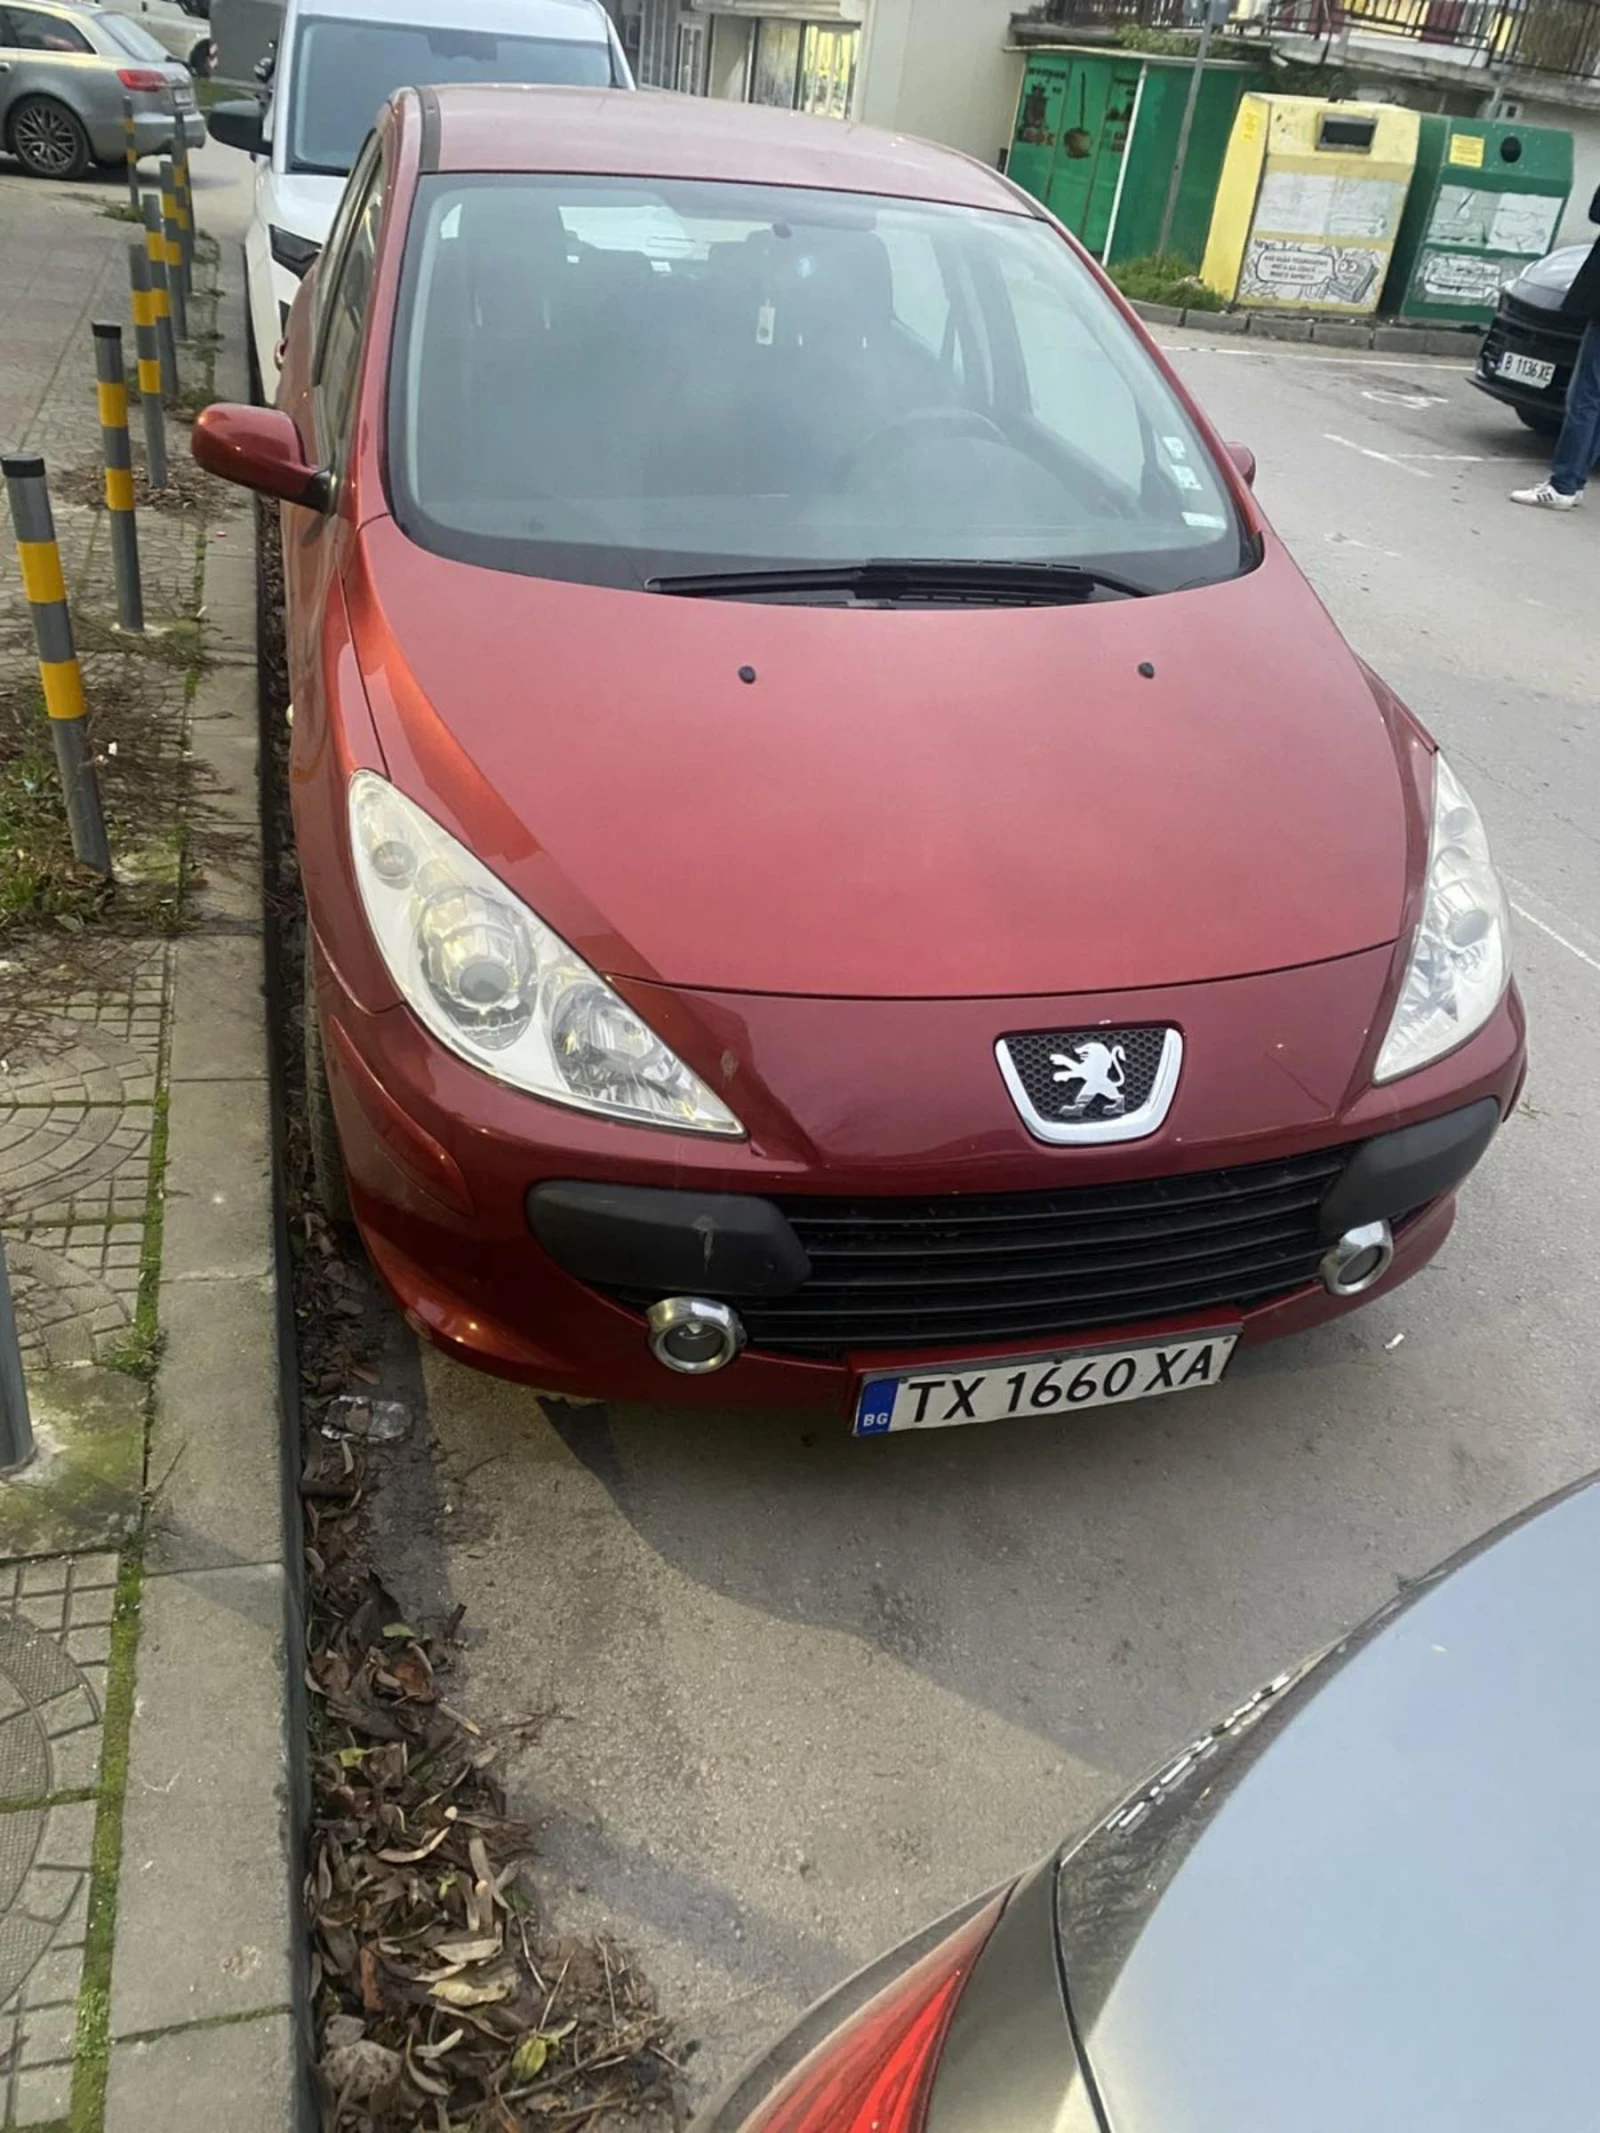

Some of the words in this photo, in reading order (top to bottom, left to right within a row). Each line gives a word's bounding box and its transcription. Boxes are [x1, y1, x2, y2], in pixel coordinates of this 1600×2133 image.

[908, 1377, 985, 1422] TX
[1006, 1357, 1137, 1412] 1660
[1142, 1344, 1214, 1392] XA
[863, 1412, 889, 1427] BG
